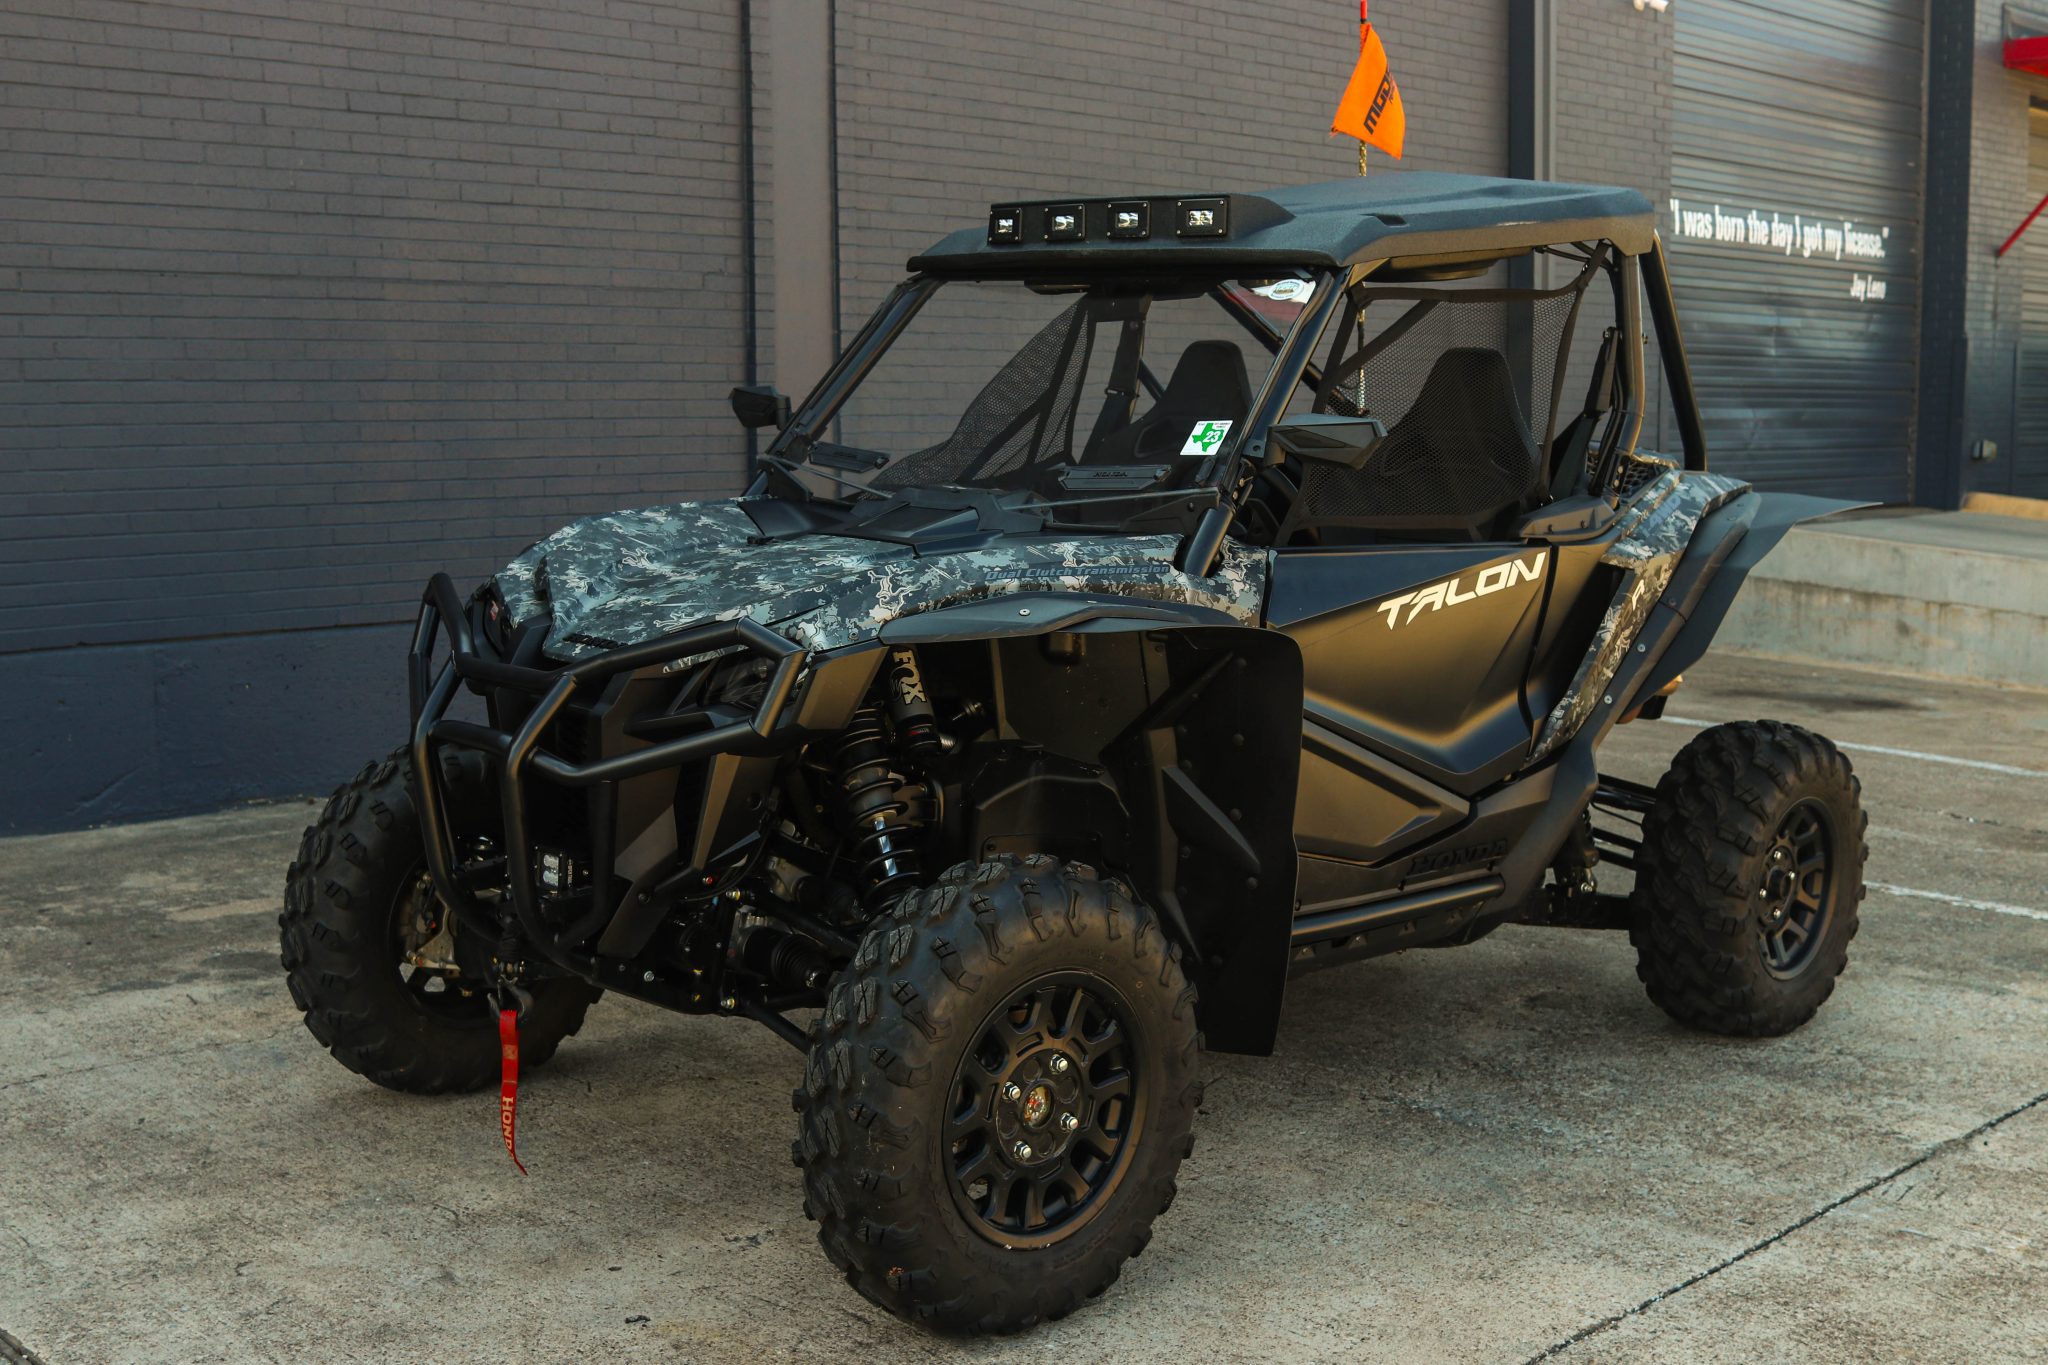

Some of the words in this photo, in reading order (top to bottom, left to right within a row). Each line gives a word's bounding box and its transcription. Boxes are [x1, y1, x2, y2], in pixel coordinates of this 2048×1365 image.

[1683, 210, 1712, 239] was
[1715, 205, 1745, 243] born
[1747, 210, 1769, 246] the
[1771, 213, 1793, 256] day
[1795, 215, 1801, 248] I
[1803, 222, 1823, 257] got
[1825, 227, 1842, 261] my
[1851, 273, 1867, 302] Jay
[1867, 275, 1887, 299] Leno
[1203, 431, 1221, 443] 23
[985, 570, 1022, 581] Dual
[1025, 567, 1072, 578] Clutch
[1075, 564, 1169, 576] Transmission
[1376, 551, 1547, 631] TALON
[892, 650, 927, 705] FOX
[502, 1096, 515, 1160] HOND
